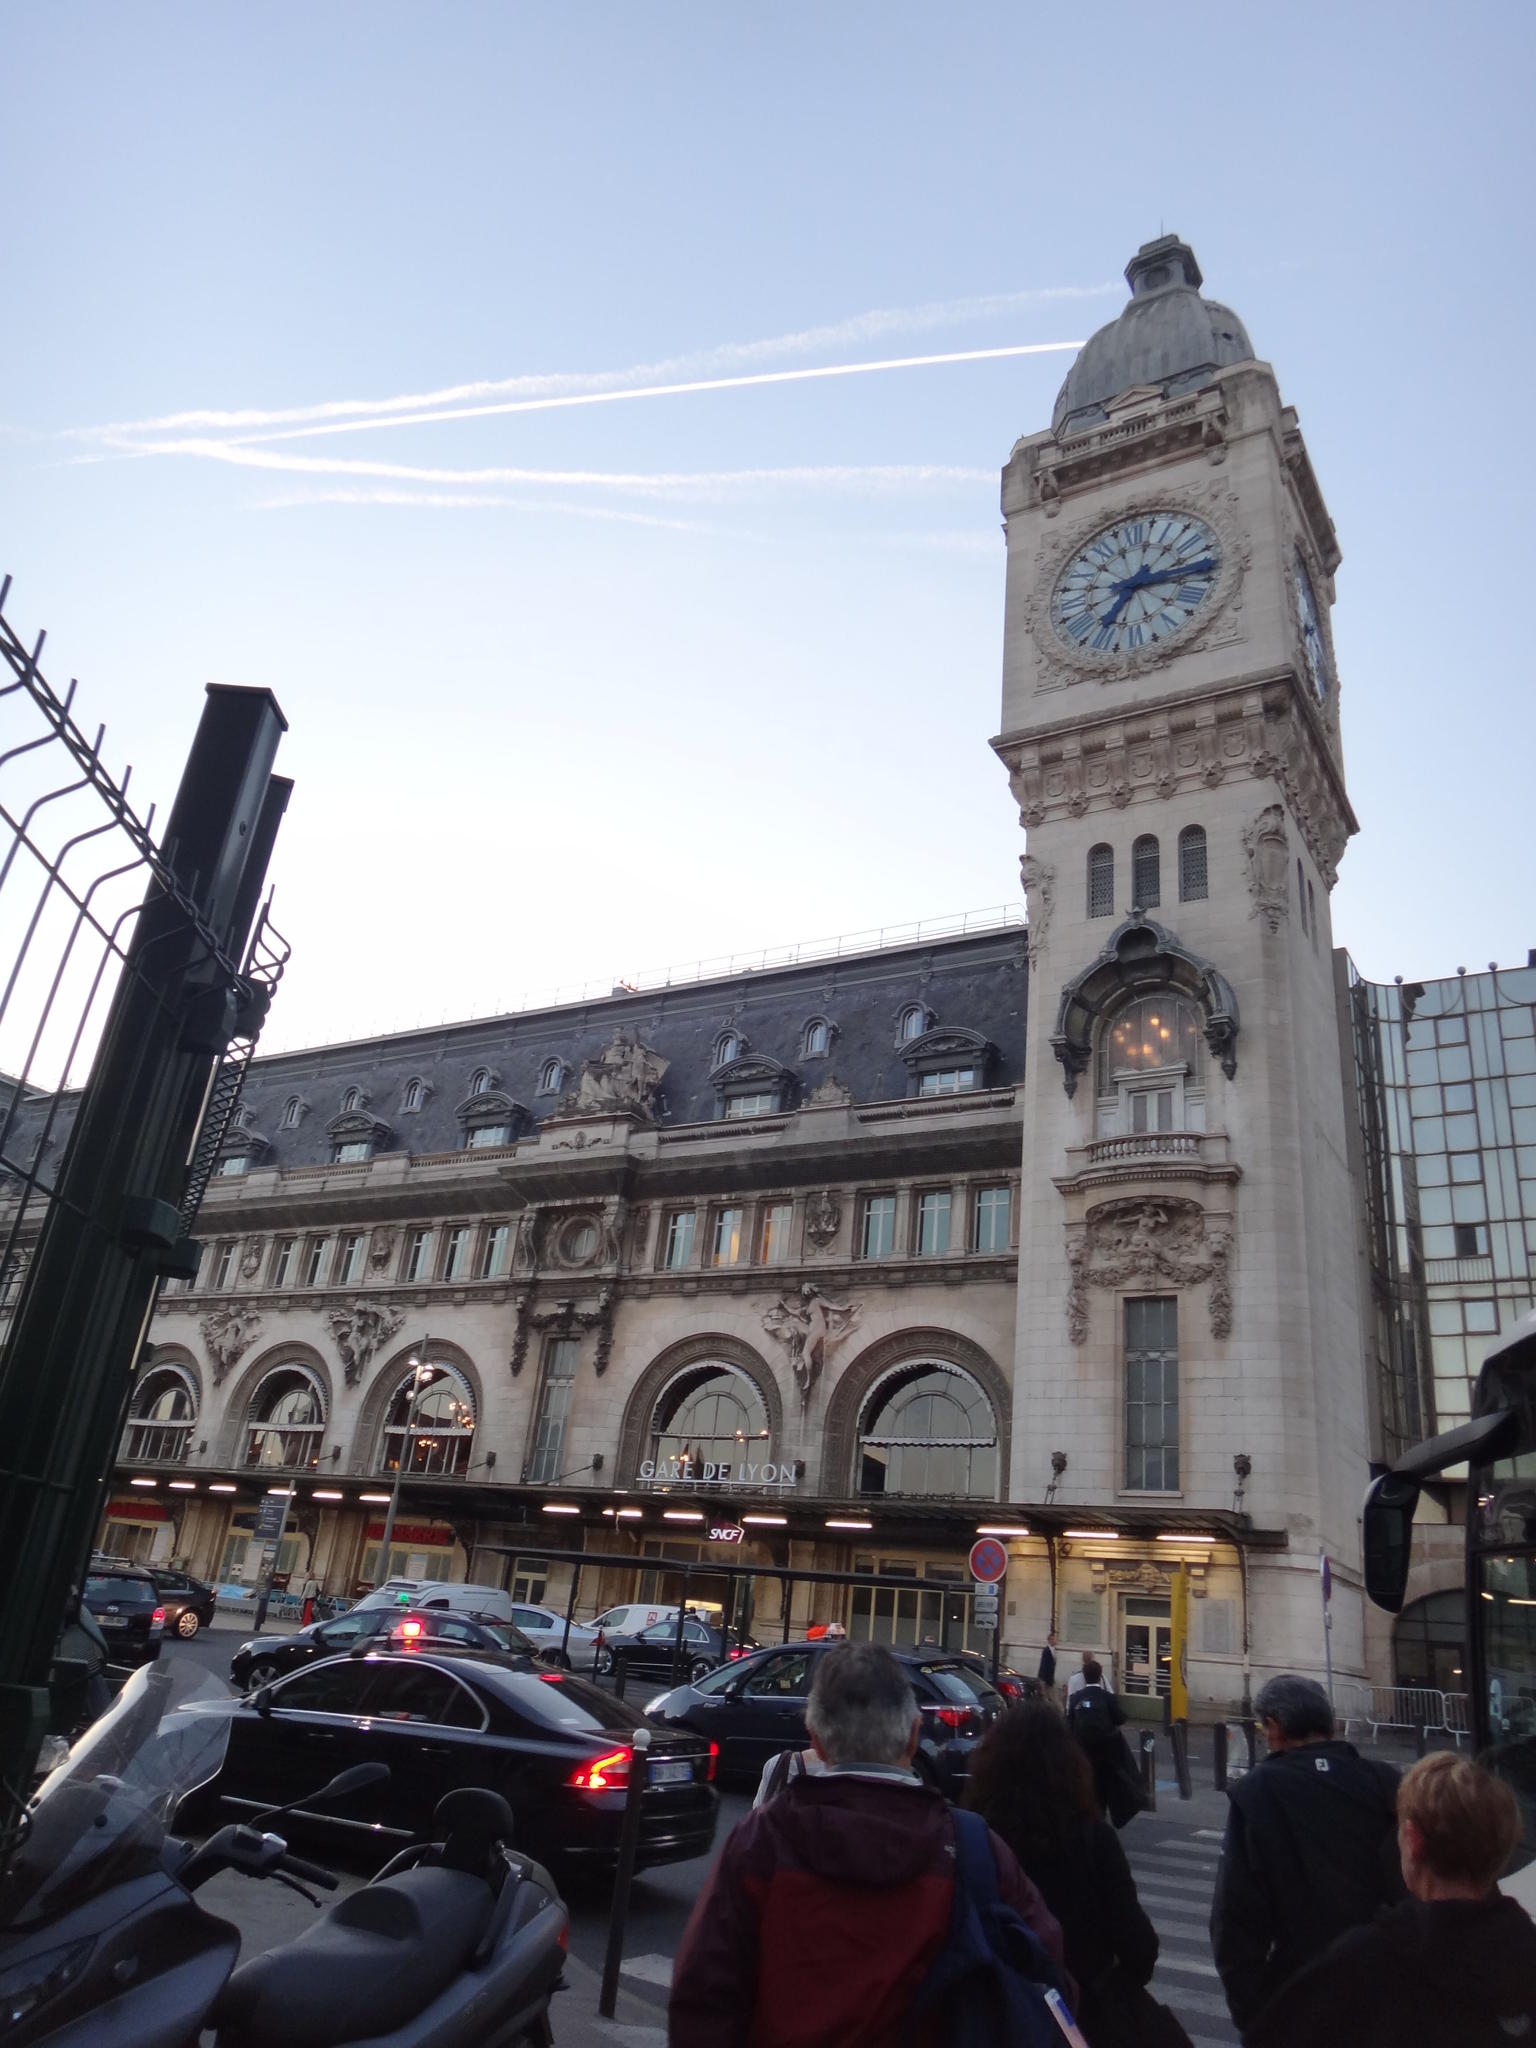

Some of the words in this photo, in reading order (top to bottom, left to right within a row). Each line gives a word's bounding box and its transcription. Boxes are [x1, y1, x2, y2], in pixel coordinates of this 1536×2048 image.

[1158, 522, 1173, 543] I
[1176, 533, 1201, 555] II
[639, 1460, 694, 1480] GARE
[703, 1462, 731, 1480] DE
[739, 1463, 797, 1483] LYON
[709, 1528, 740, 1540] SNCF
